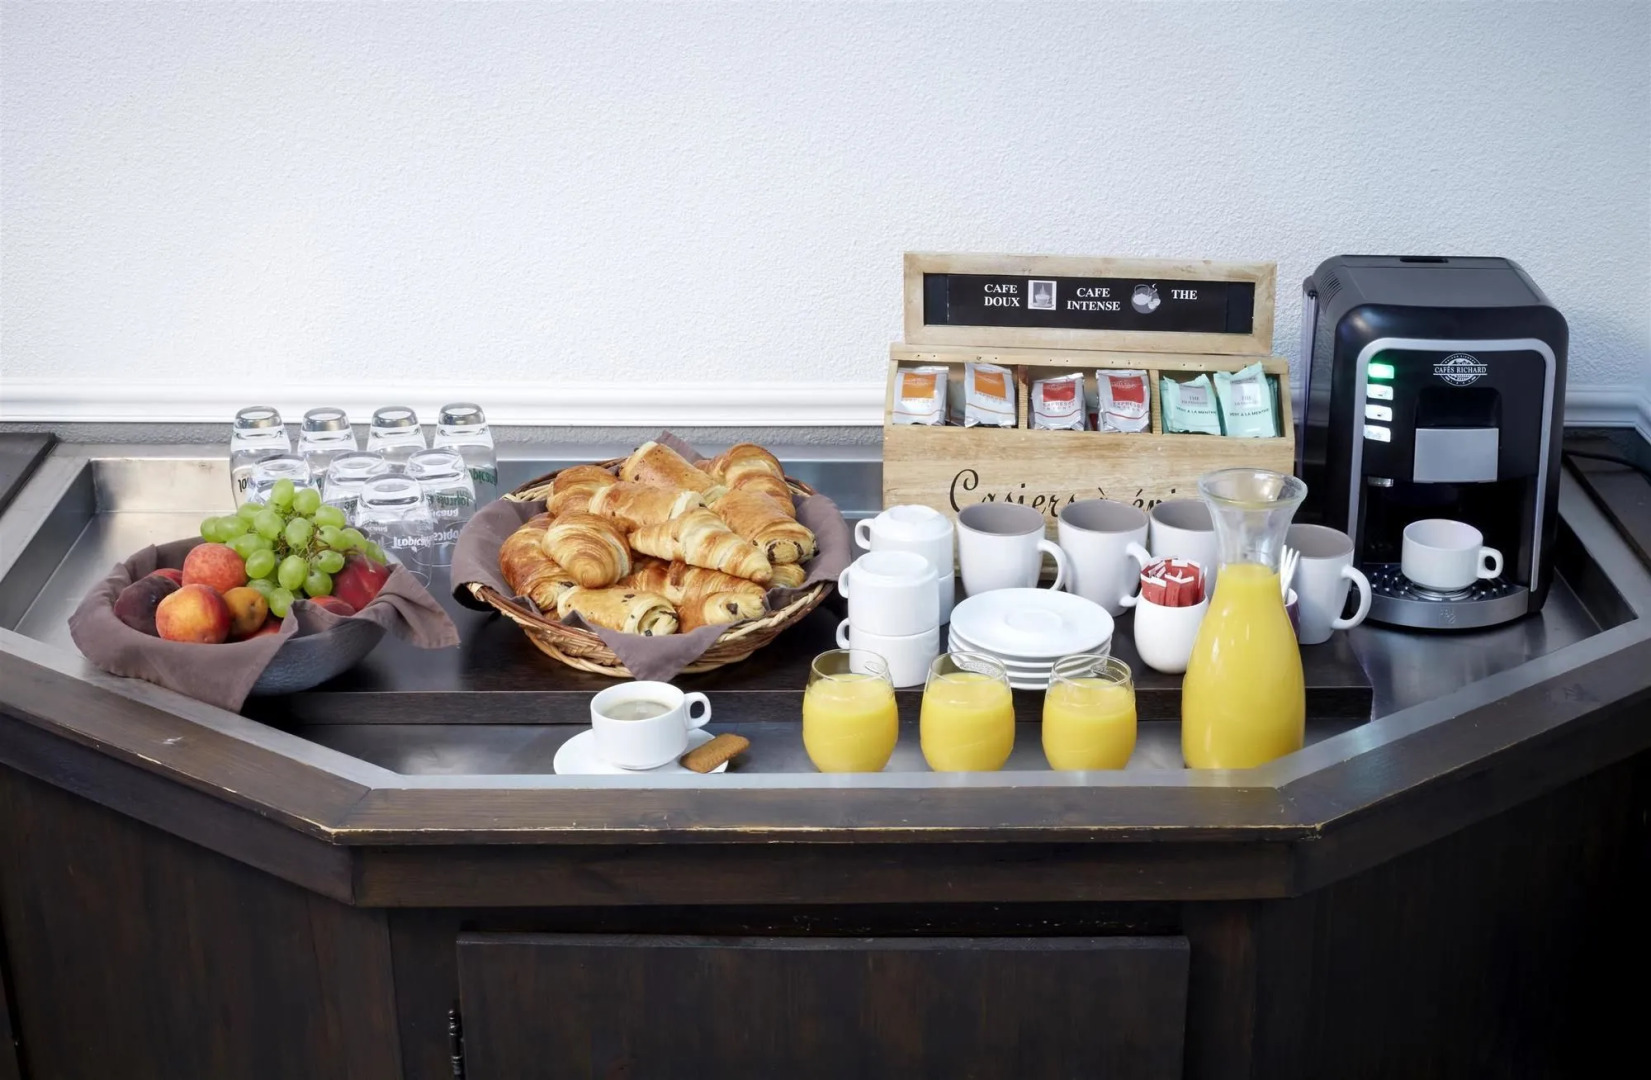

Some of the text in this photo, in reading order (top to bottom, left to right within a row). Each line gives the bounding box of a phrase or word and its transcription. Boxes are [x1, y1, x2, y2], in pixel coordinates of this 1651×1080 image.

[984, 283, 1018, 294] CAFE
[1076, 287, 1111, 298] CAFE
[1171, 289, 1198, 300] THE
[984, 296, 1020, 307] DOUX
[1066, 300, 1121, 311] INTENSE
[1434, 365, 1487, 374] CAFÉS RICHARD
